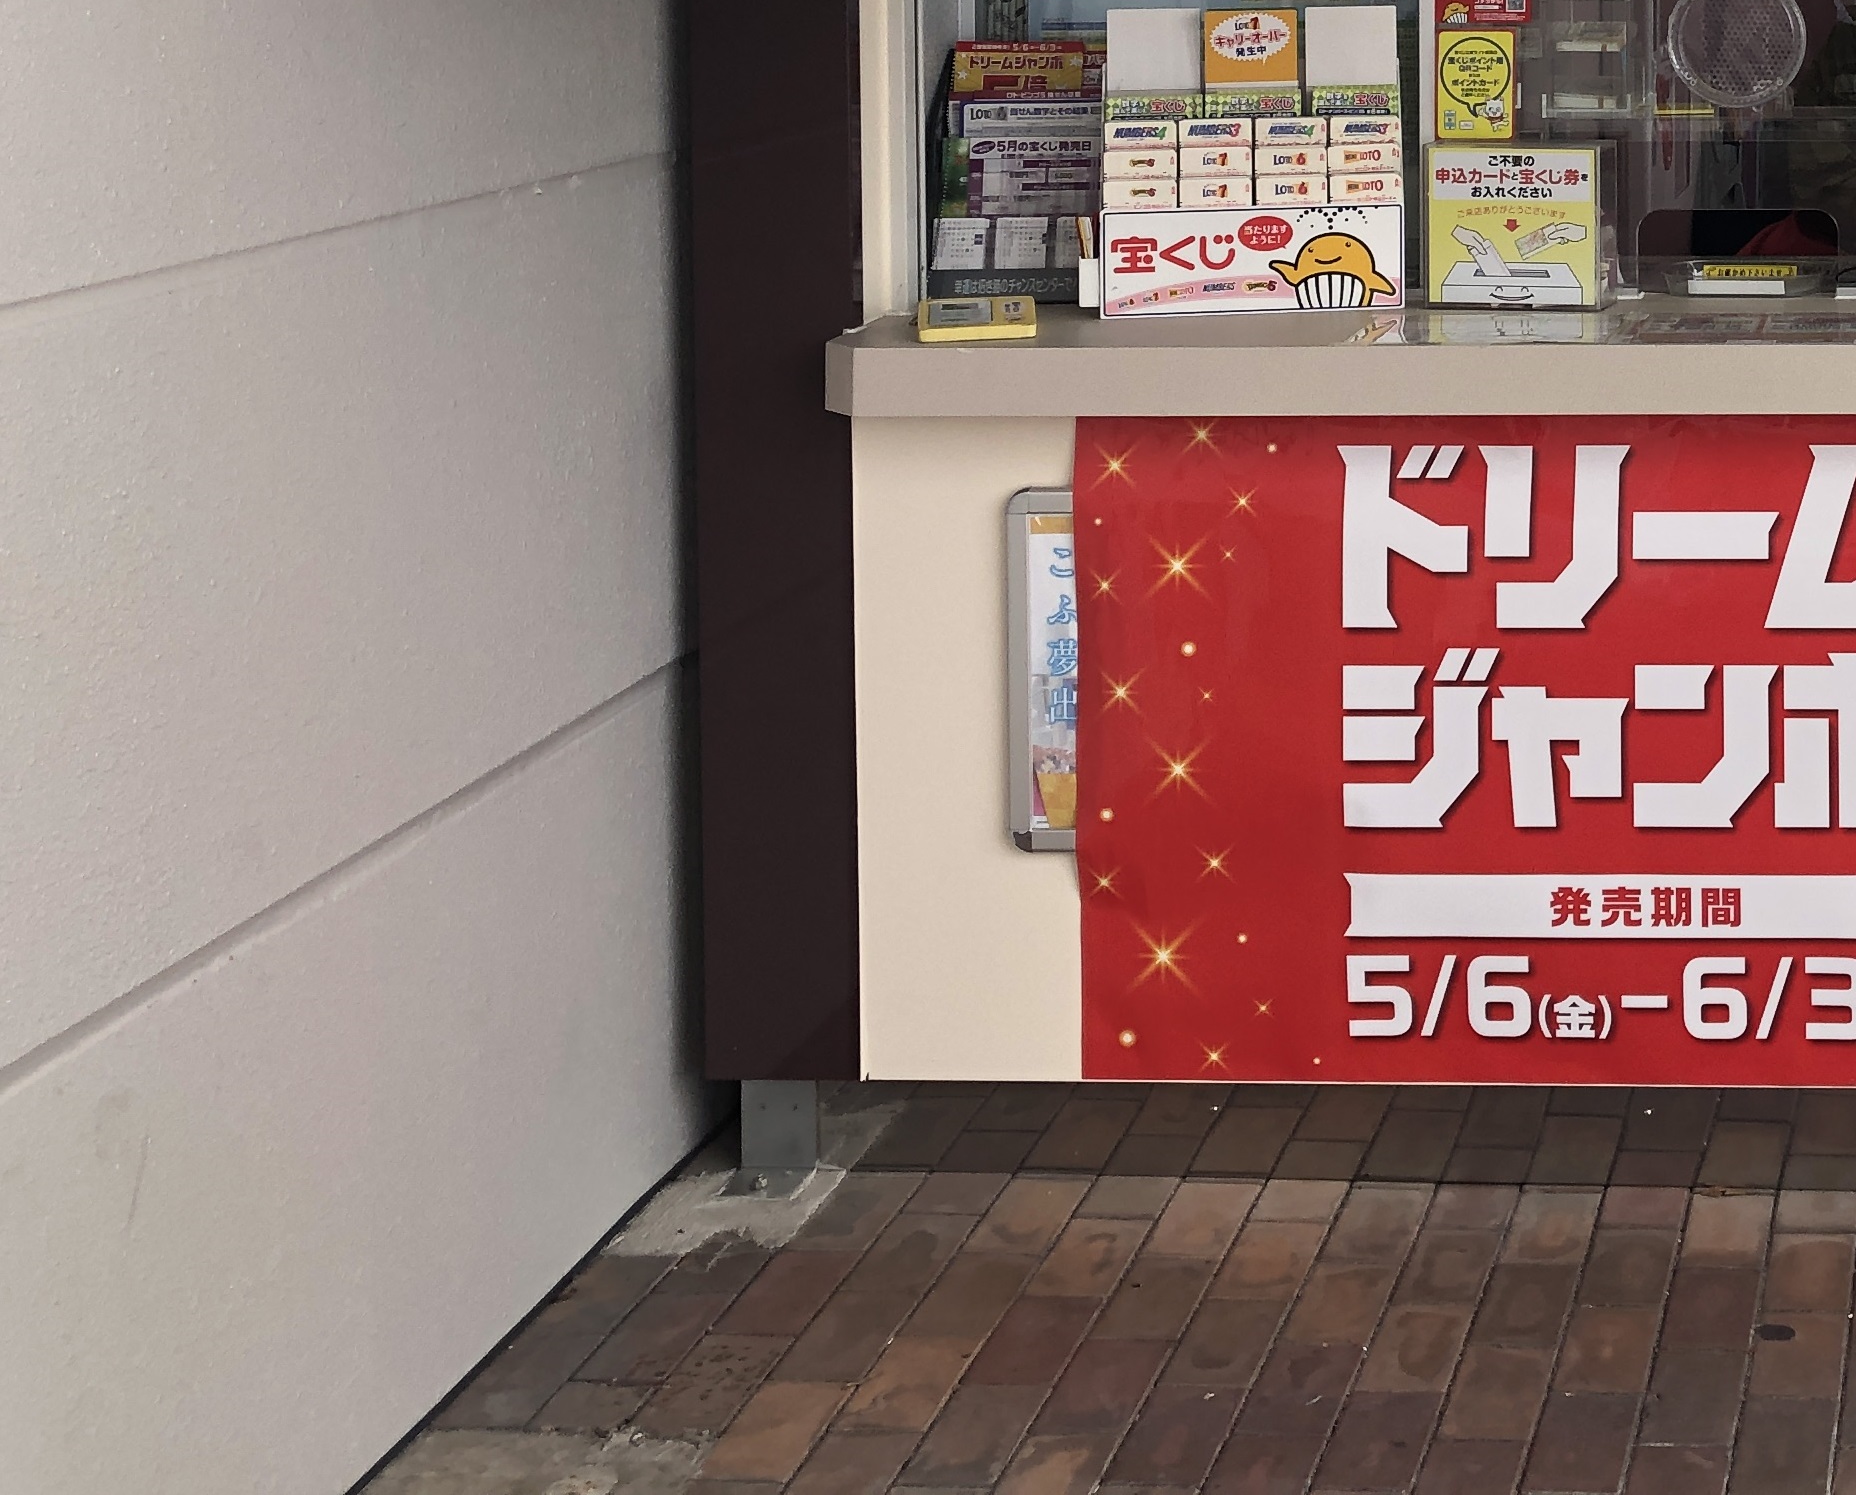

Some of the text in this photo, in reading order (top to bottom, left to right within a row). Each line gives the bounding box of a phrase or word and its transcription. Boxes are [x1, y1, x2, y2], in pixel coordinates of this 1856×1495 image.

[1213, 30, 1287, 49] キャリーオーバー
[1235, 45, 1267, 57] 発生中
[969, 56, 1063, 70] ドリームジャンボ
[1451, 79, 1500, 87] ポイントカード
[1151, 99, 1186, 113] 宝くじ
[1260, 96, 1295, 110] 宝くじ
[1354, 93, 1389, 107] 宝くじ
[997, 141, 1091, 152] 5月の宝くじ発売日
[1360, 149, 1381, 161] LOTO
[1488, 156, 1535, 167] ご不要の
[1435, 168, 1589, 186] 申込カードと宝くじ券を
[1362, 180, 1384, 192] LOTO
[1471, 187, 1553, 198] お入れください
[1457, 206, 1566, 219] ご来店ありがとうございます
[1243, 225, 1288, 235] 当たります
[1249, 235, 1282, 245] ように!
[1110, 234, 1236, 273] 宝くじ
[1203, 282, 1236, 292] NUMBERS
[1548, 885, 1744, 928] 発売期間
